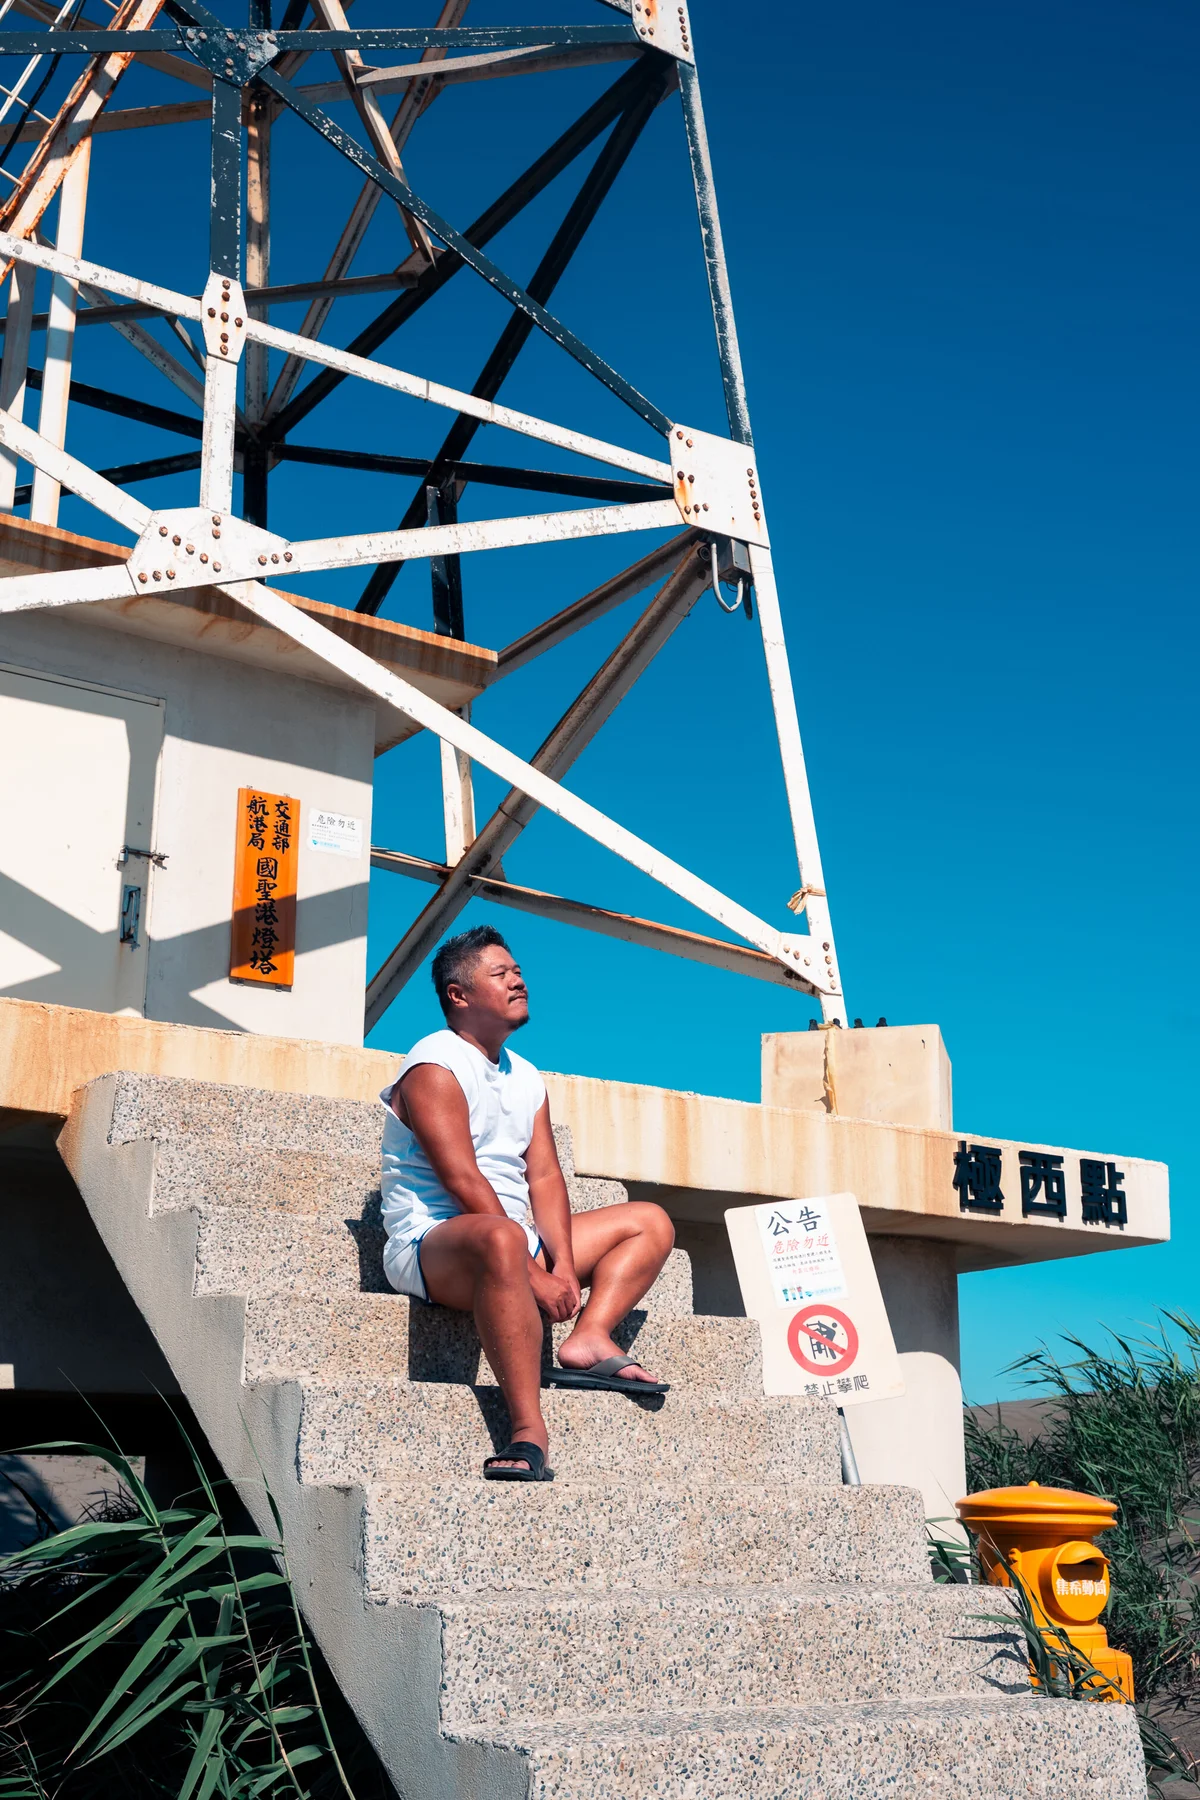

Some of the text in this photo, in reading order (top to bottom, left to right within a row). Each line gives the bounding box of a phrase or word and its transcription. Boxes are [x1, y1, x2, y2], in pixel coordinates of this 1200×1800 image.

[246, 795, 269, 851] 航港局
[272, 800, 292, 854] 交通部
[316, 814, 355, 831] 危險勿近
[249, 856, 279, 976] 國聖港燈塔
[953, 1141, 1127, 1228] 極西點
[767, 1206, 821, 1236] 公告
[771, 1232, 830, 1255] 危險勿近
[803, 1374, 870, 1397] 禁止攀爬
